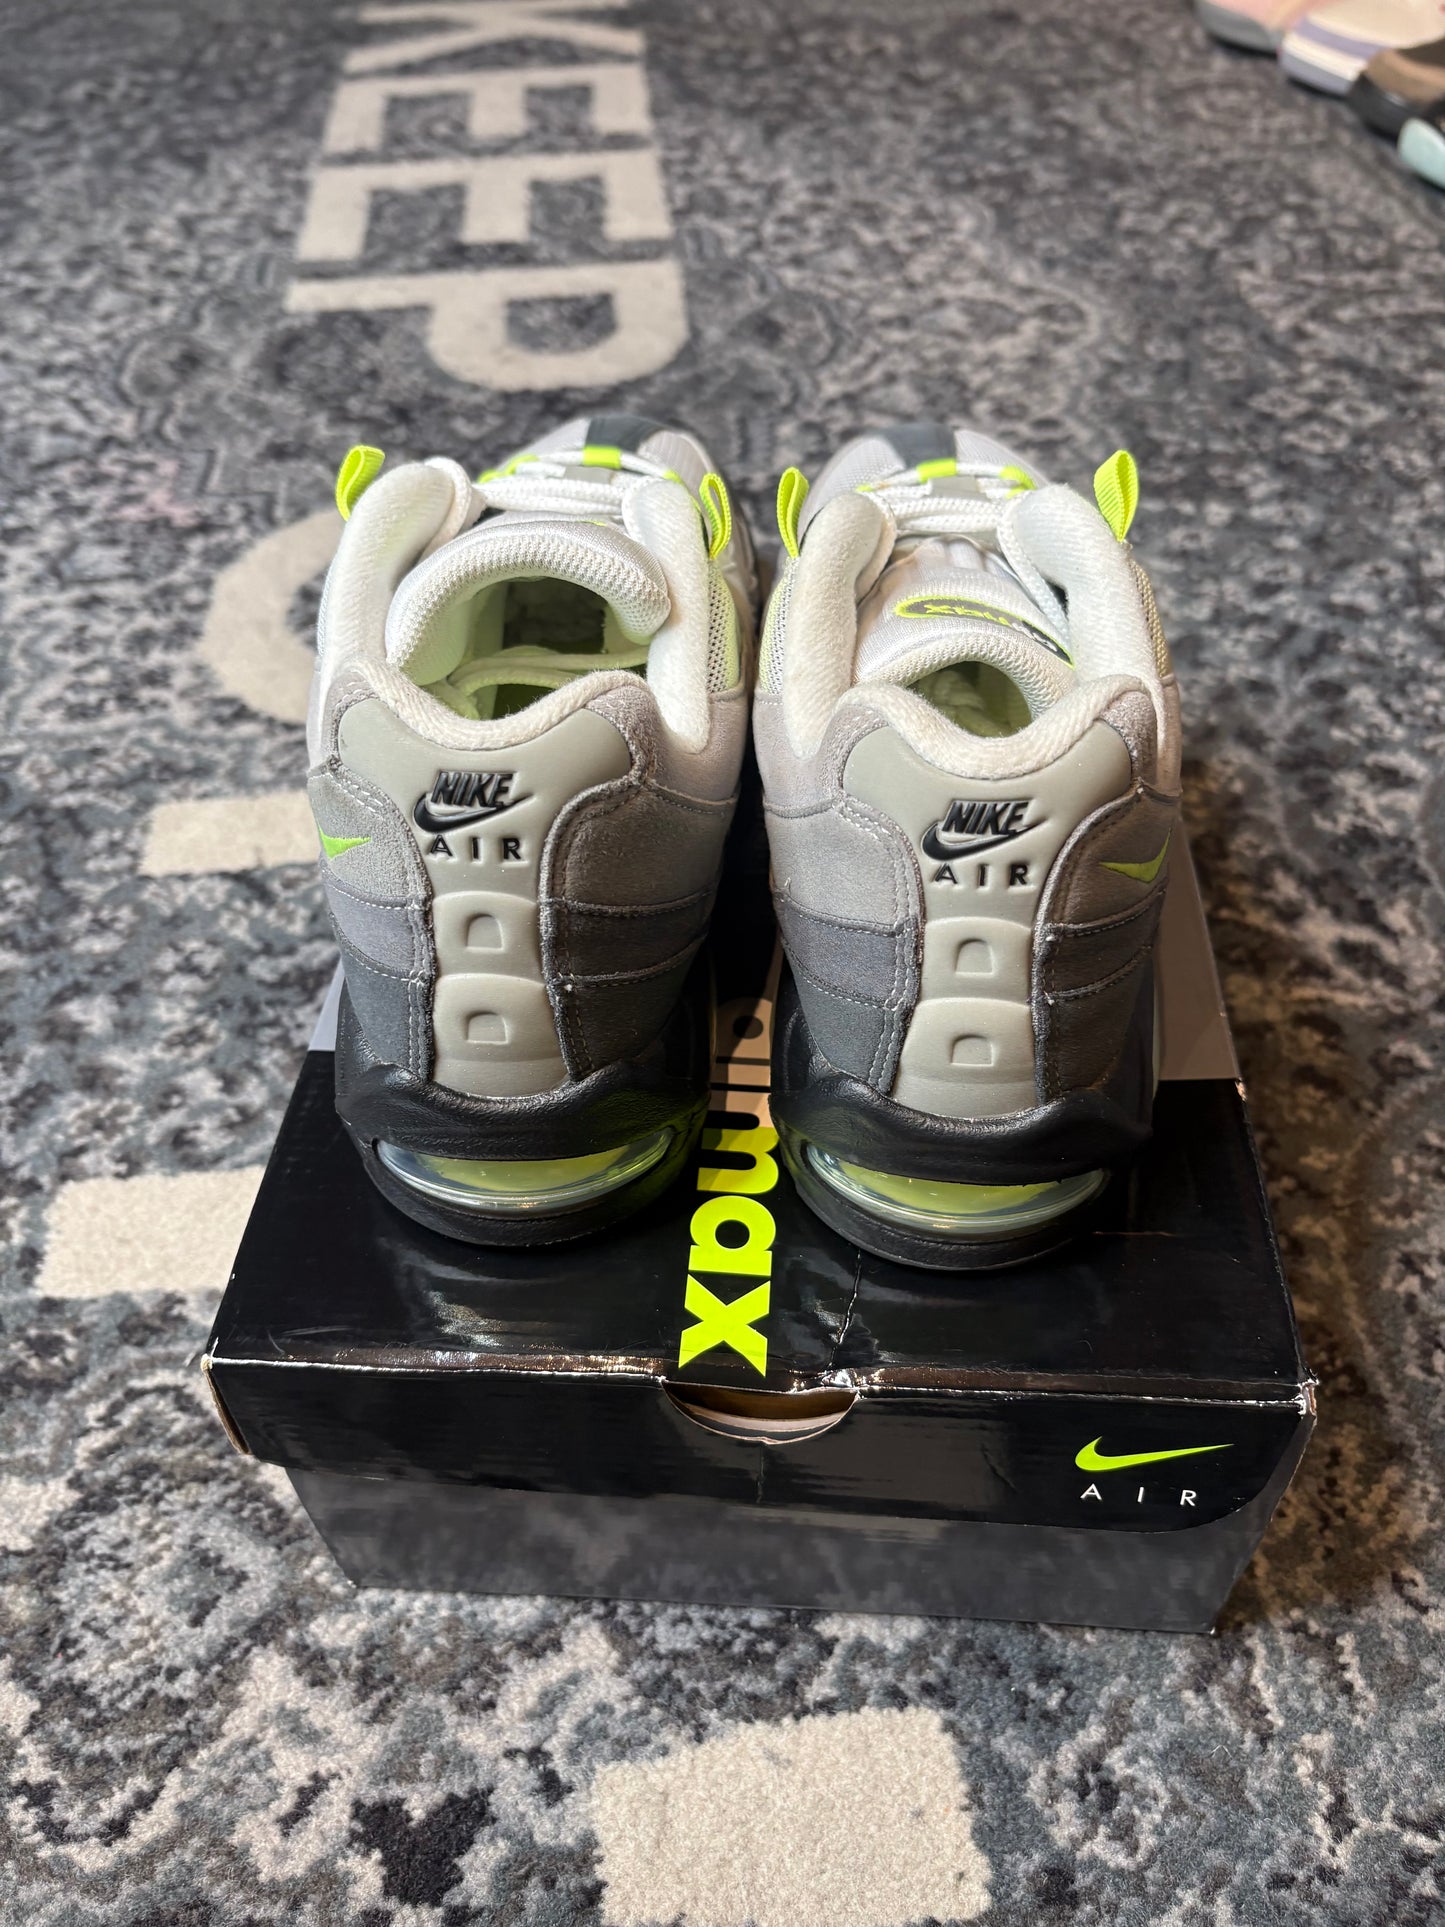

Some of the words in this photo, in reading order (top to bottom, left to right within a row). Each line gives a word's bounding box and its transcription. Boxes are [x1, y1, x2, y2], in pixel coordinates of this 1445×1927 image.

[284, 0, 690, 391] KEEP
[430, 771, 513, 807] NIKE
[941, 801, 1029, 836] NIKE
[429, 834, 522, 860] AIR
[934, 863, 1028, 887] AIR
[1080, 1483, 1197, 1507] AIR
